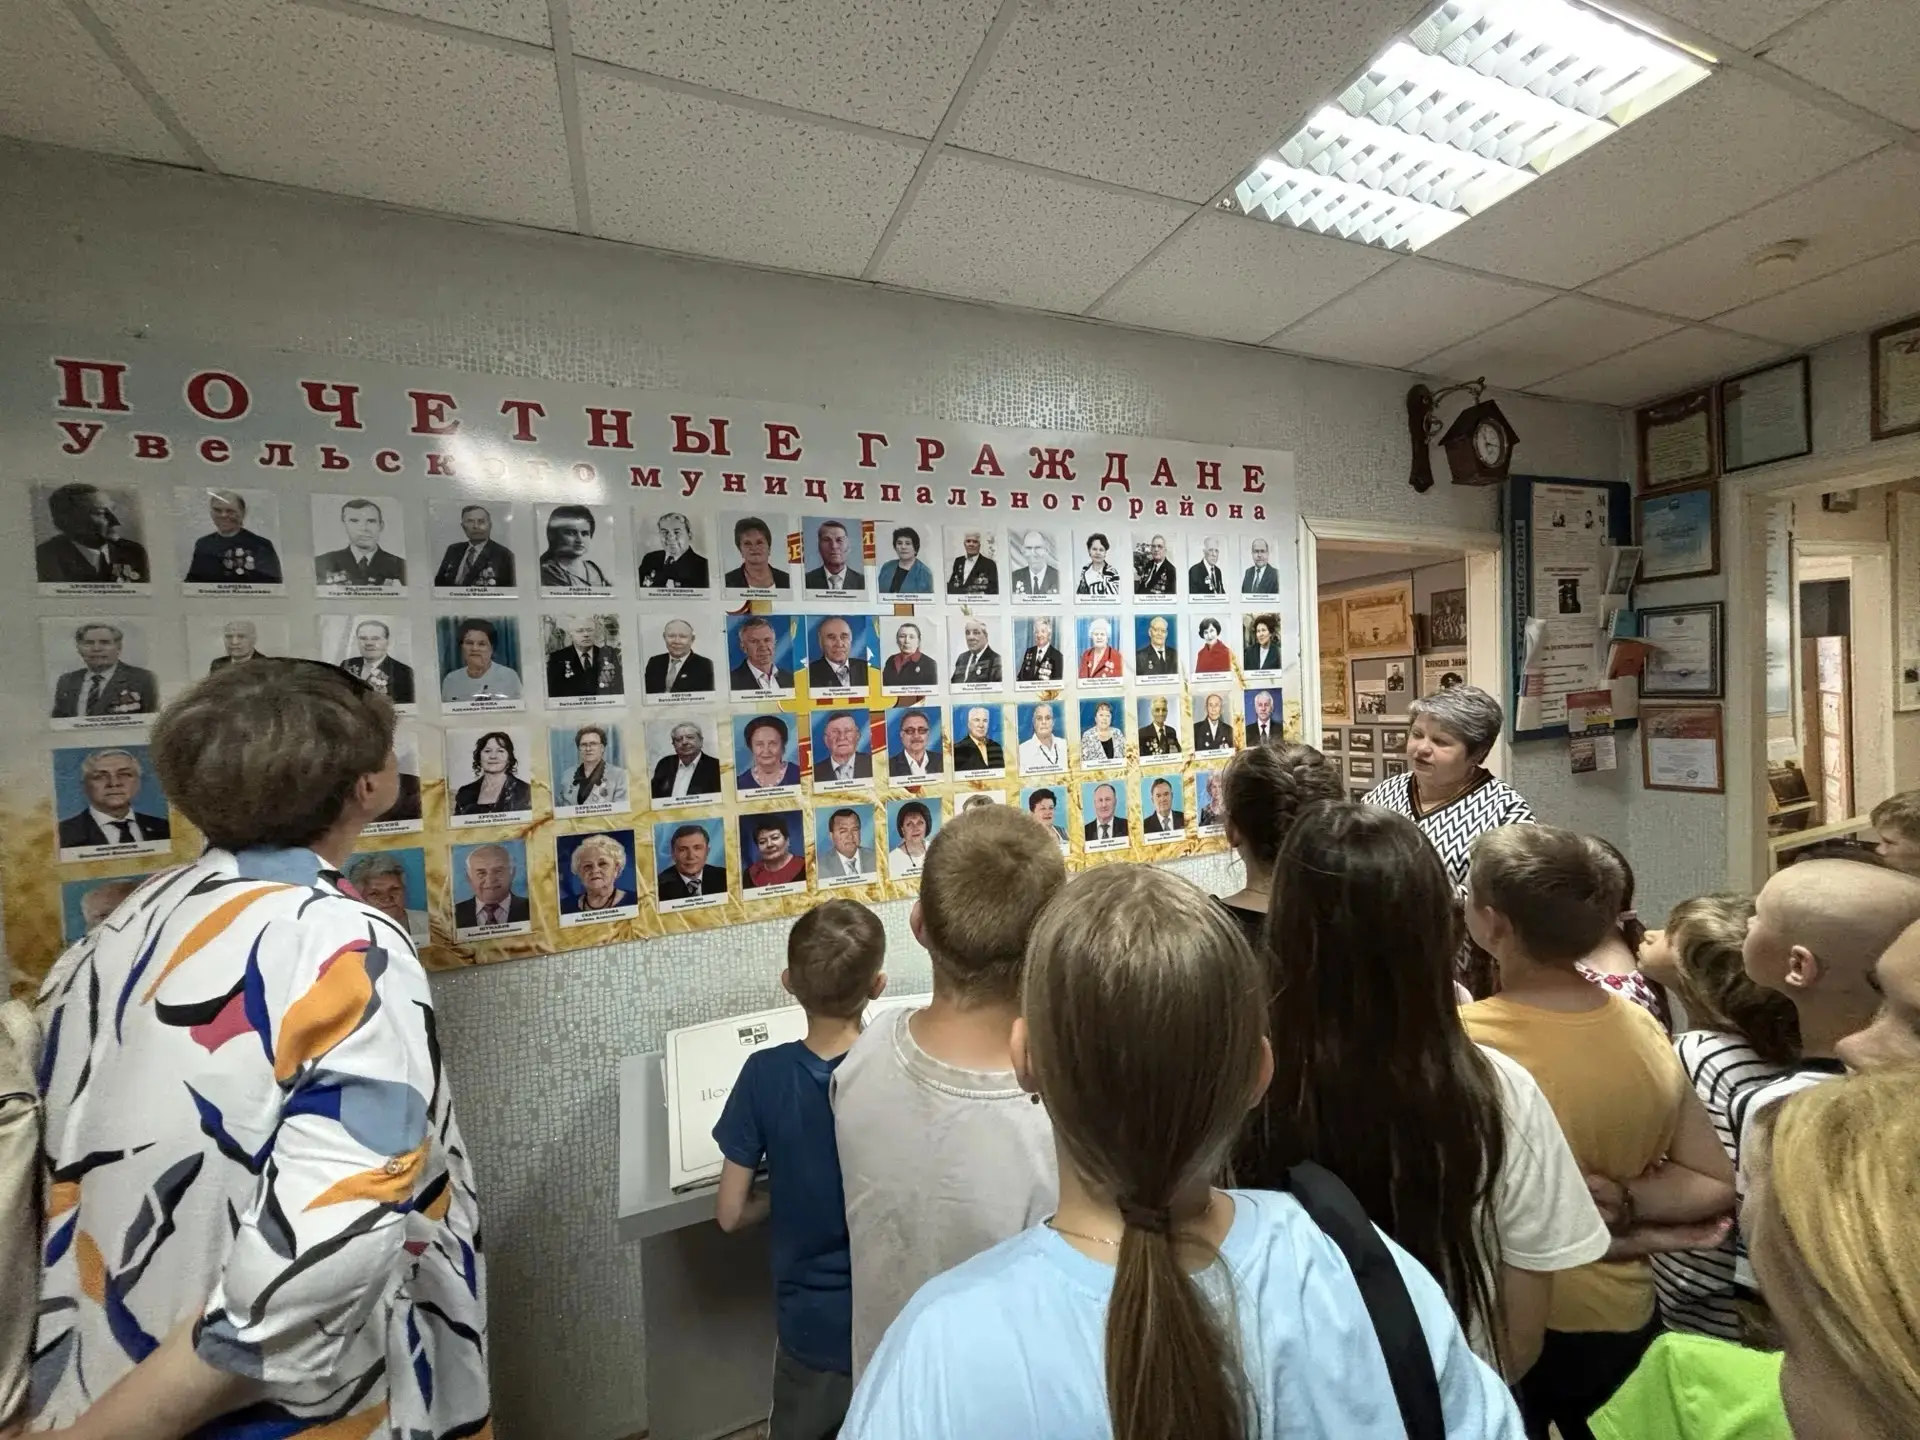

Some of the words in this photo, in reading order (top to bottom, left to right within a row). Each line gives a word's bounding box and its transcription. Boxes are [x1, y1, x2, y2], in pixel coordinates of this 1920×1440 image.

[55, 358, 803, 463] ПОЧЕТНЫЕ
[857, 431, 1266, 494] ГРАЖДАНЕ
[57, 421, 596, 484] Увельского
[631, 466, 1113, 513] муниципального
[1129, 497, 1266, 519] района
[1597, 494, 1606, 547] МЧС
[1516, 525, 1528, 661] ИНФОРМИРУЕ
